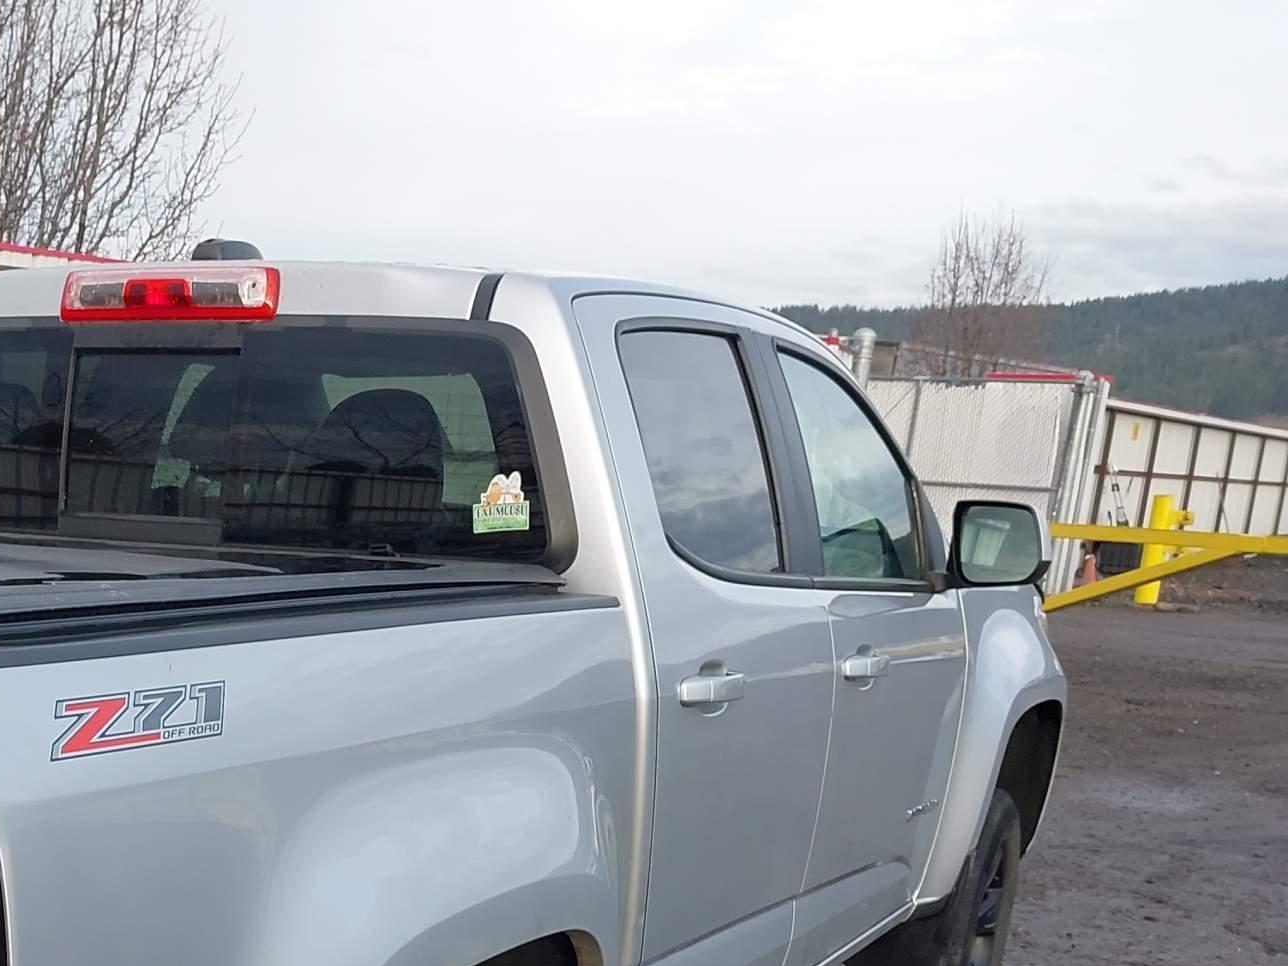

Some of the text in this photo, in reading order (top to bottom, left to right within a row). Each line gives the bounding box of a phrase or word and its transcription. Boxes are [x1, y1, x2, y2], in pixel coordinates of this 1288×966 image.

[50, 680, 225, 762] Z71
[162, 722, 220, 740] OFF ROAD
